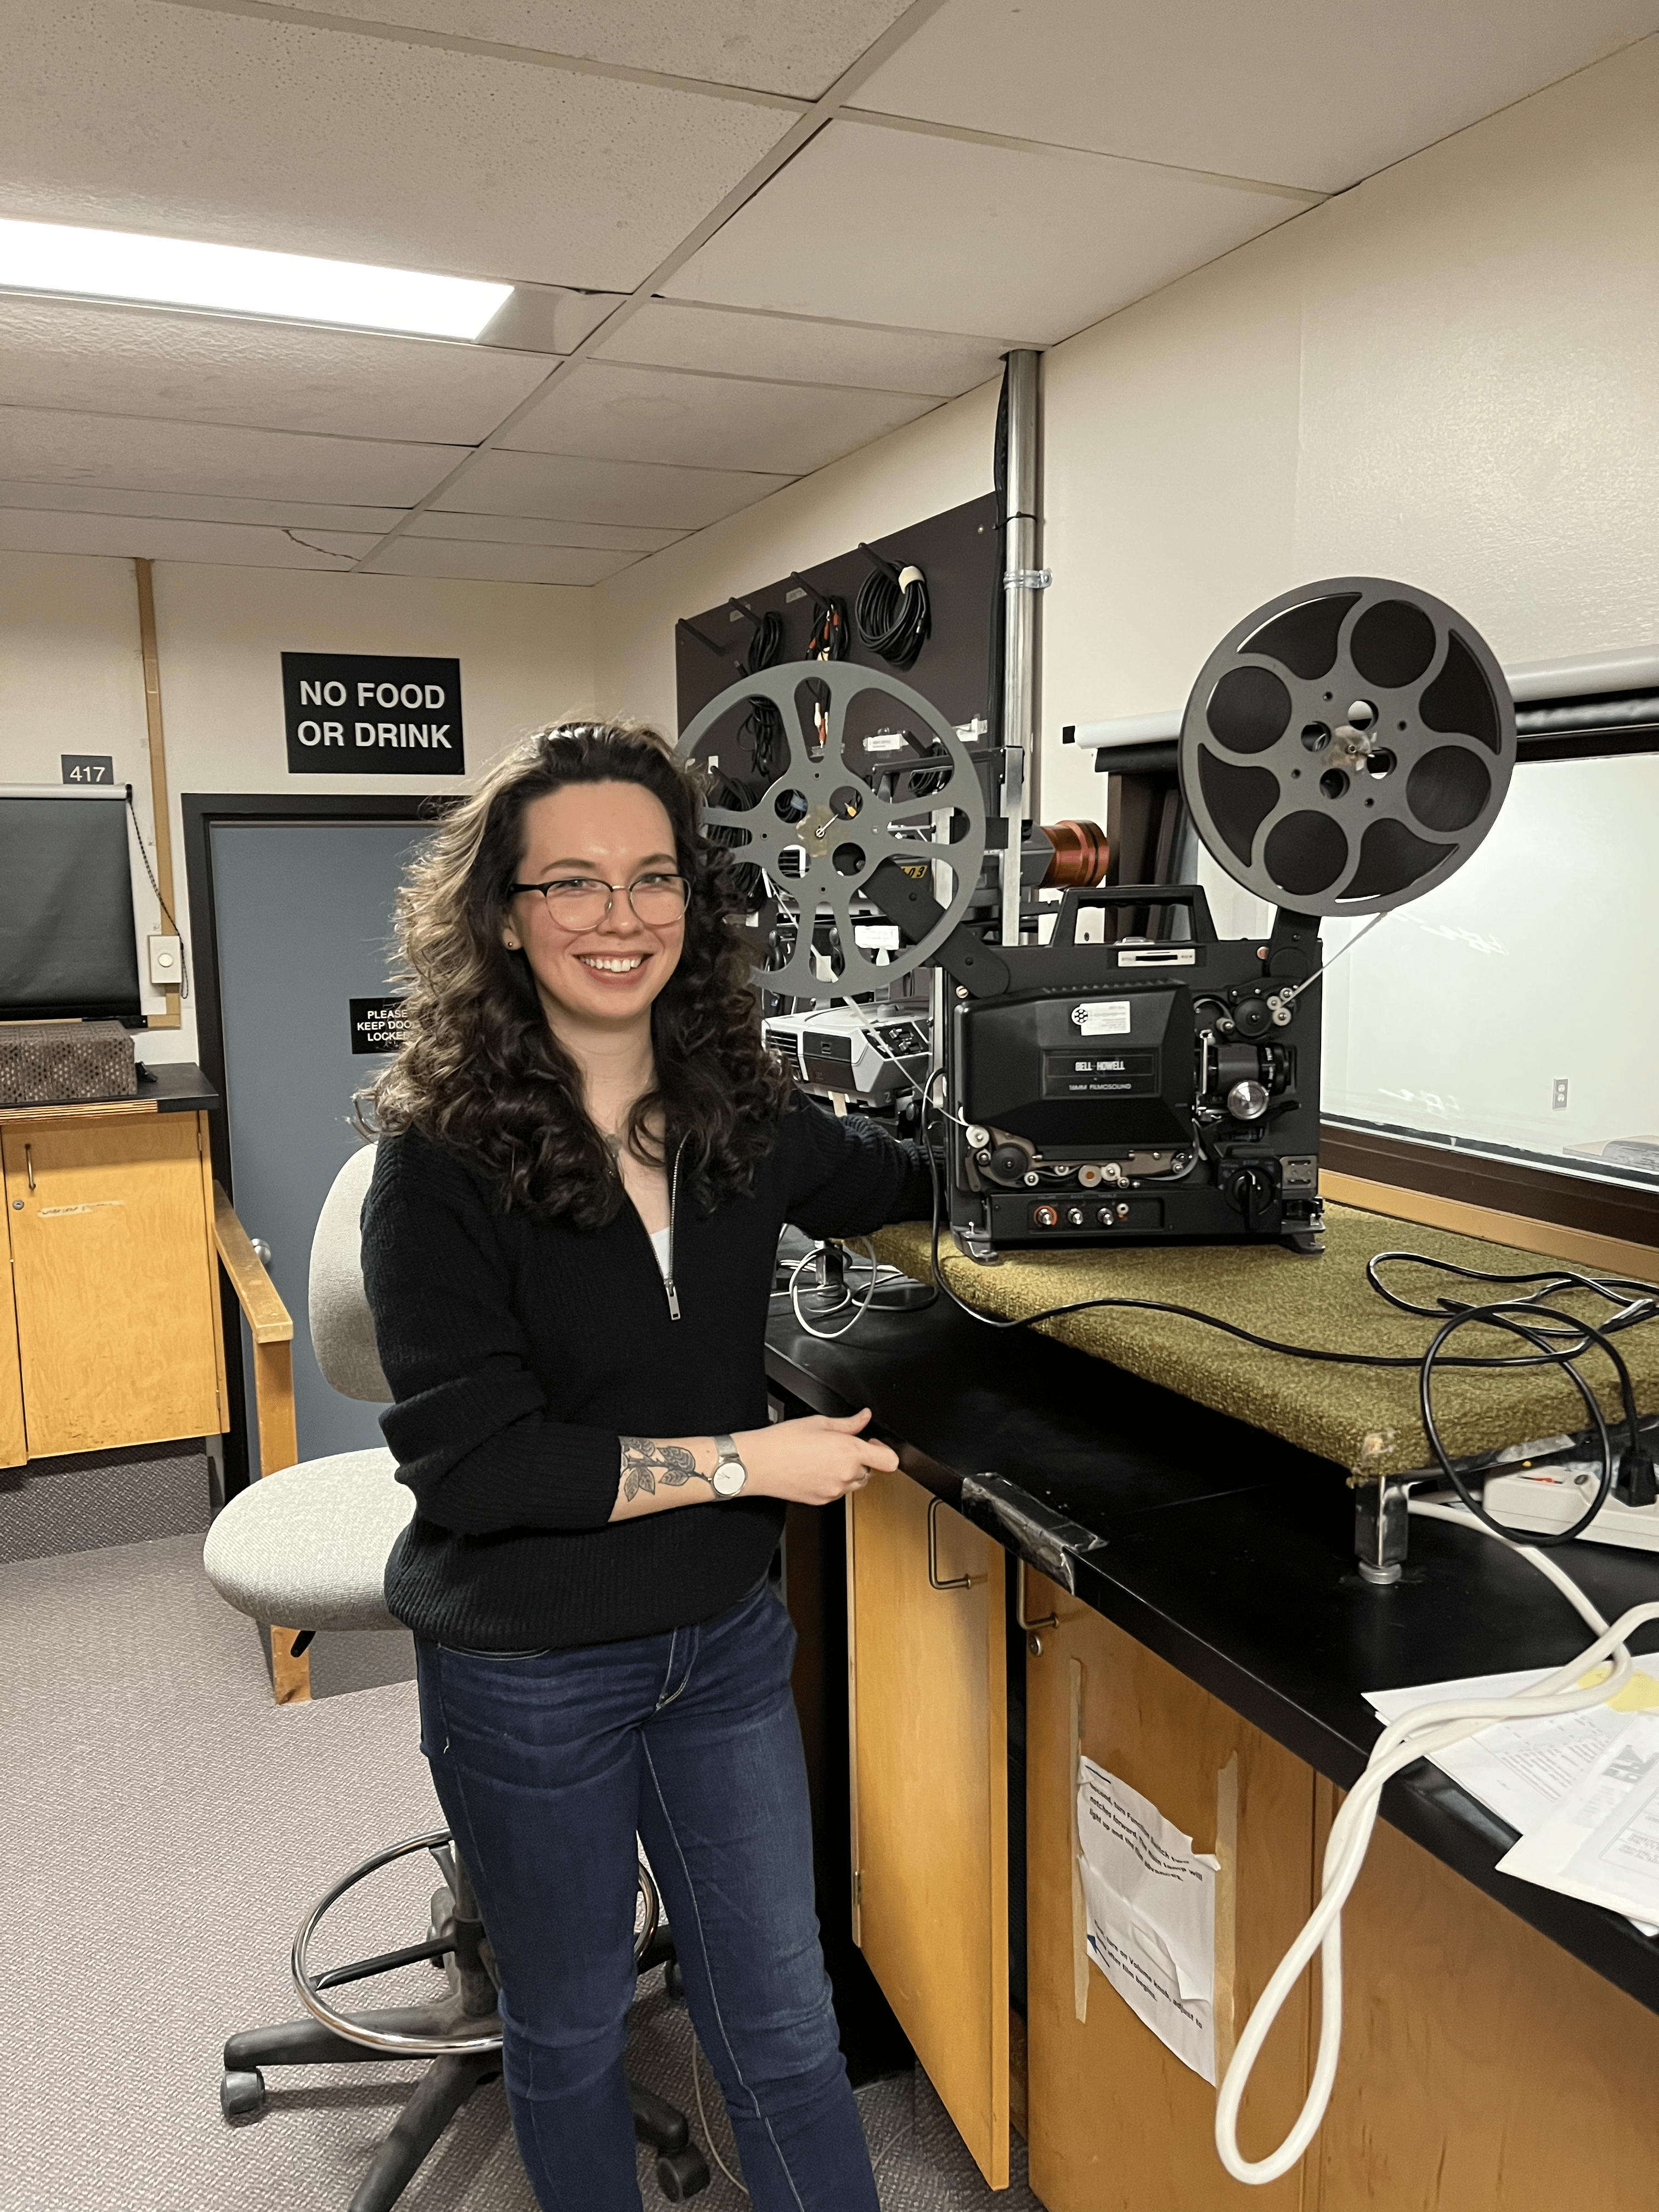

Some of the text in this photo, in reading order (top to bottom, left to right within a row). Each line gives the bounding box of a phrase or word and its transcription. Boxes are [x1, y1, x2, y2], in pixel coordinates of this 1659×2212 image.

[300, 680, 445, 709] NO FOOD
[297, 720, 452, 748] OR DRINK
[70, 766, 105, 782] 417
[367, 1009, 408, 1019] PLEASE
[357, 1021, 385, 1031] KEEP
[1120, 1950, 1127, 1960] on
[1173, 1999, 1193, 2021] adjust
[1196, 2018, 1203, 2029] to
